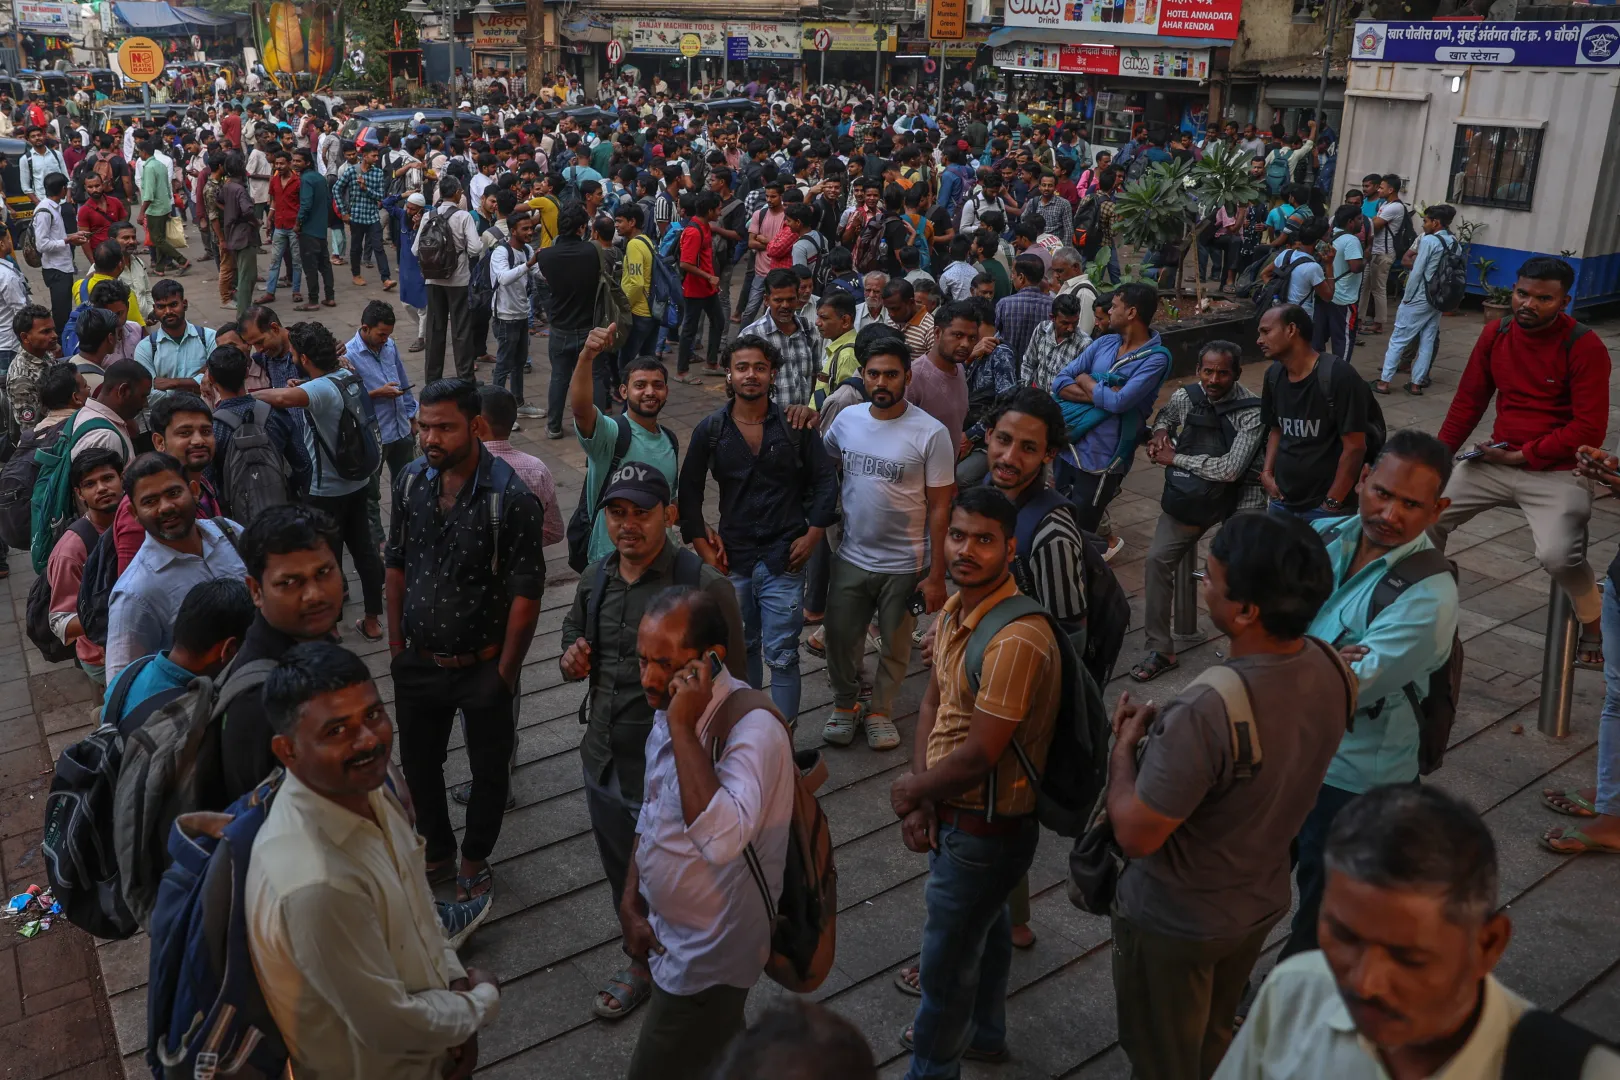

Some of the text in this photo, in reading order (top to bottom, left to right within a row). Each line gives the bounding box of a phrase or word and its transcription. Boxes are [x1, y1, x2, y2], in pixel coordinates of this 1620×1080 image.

[1038, 16, 1060, 25] Drinks
[1166, 9, 1233, 21] HOTEL ANNADATA
[638, 21, 662, 30] SANJAY
[663, 22, 693, 31] MACHINE
[695, 23, 715, 31] TOOLS
[1162, 20, 1215, 31] AHAR KENDRA
[1387, 28, 1405, 40] खार
[1405, 24, 1433, 41] पोलीस
[1434, 25, 1455, 43] ठाणे,
[1457, 25, 1478, 45] मुंबई
[1510, 26, 1527, 42] बीट
[1527, 29, 1541, 42] क्र.
[1554, 23, 1581, 42] चौकी
[994, 48, 1015, 62] GINA
[1101, 48, 1118, 57] आहार
[1449, 49, 1500, 62] खार स्टेशन
[1122, 56, 1150, 71] GINA
[611, 465, 648, 485] BOY
[864, 457, 905, 482] BEST
